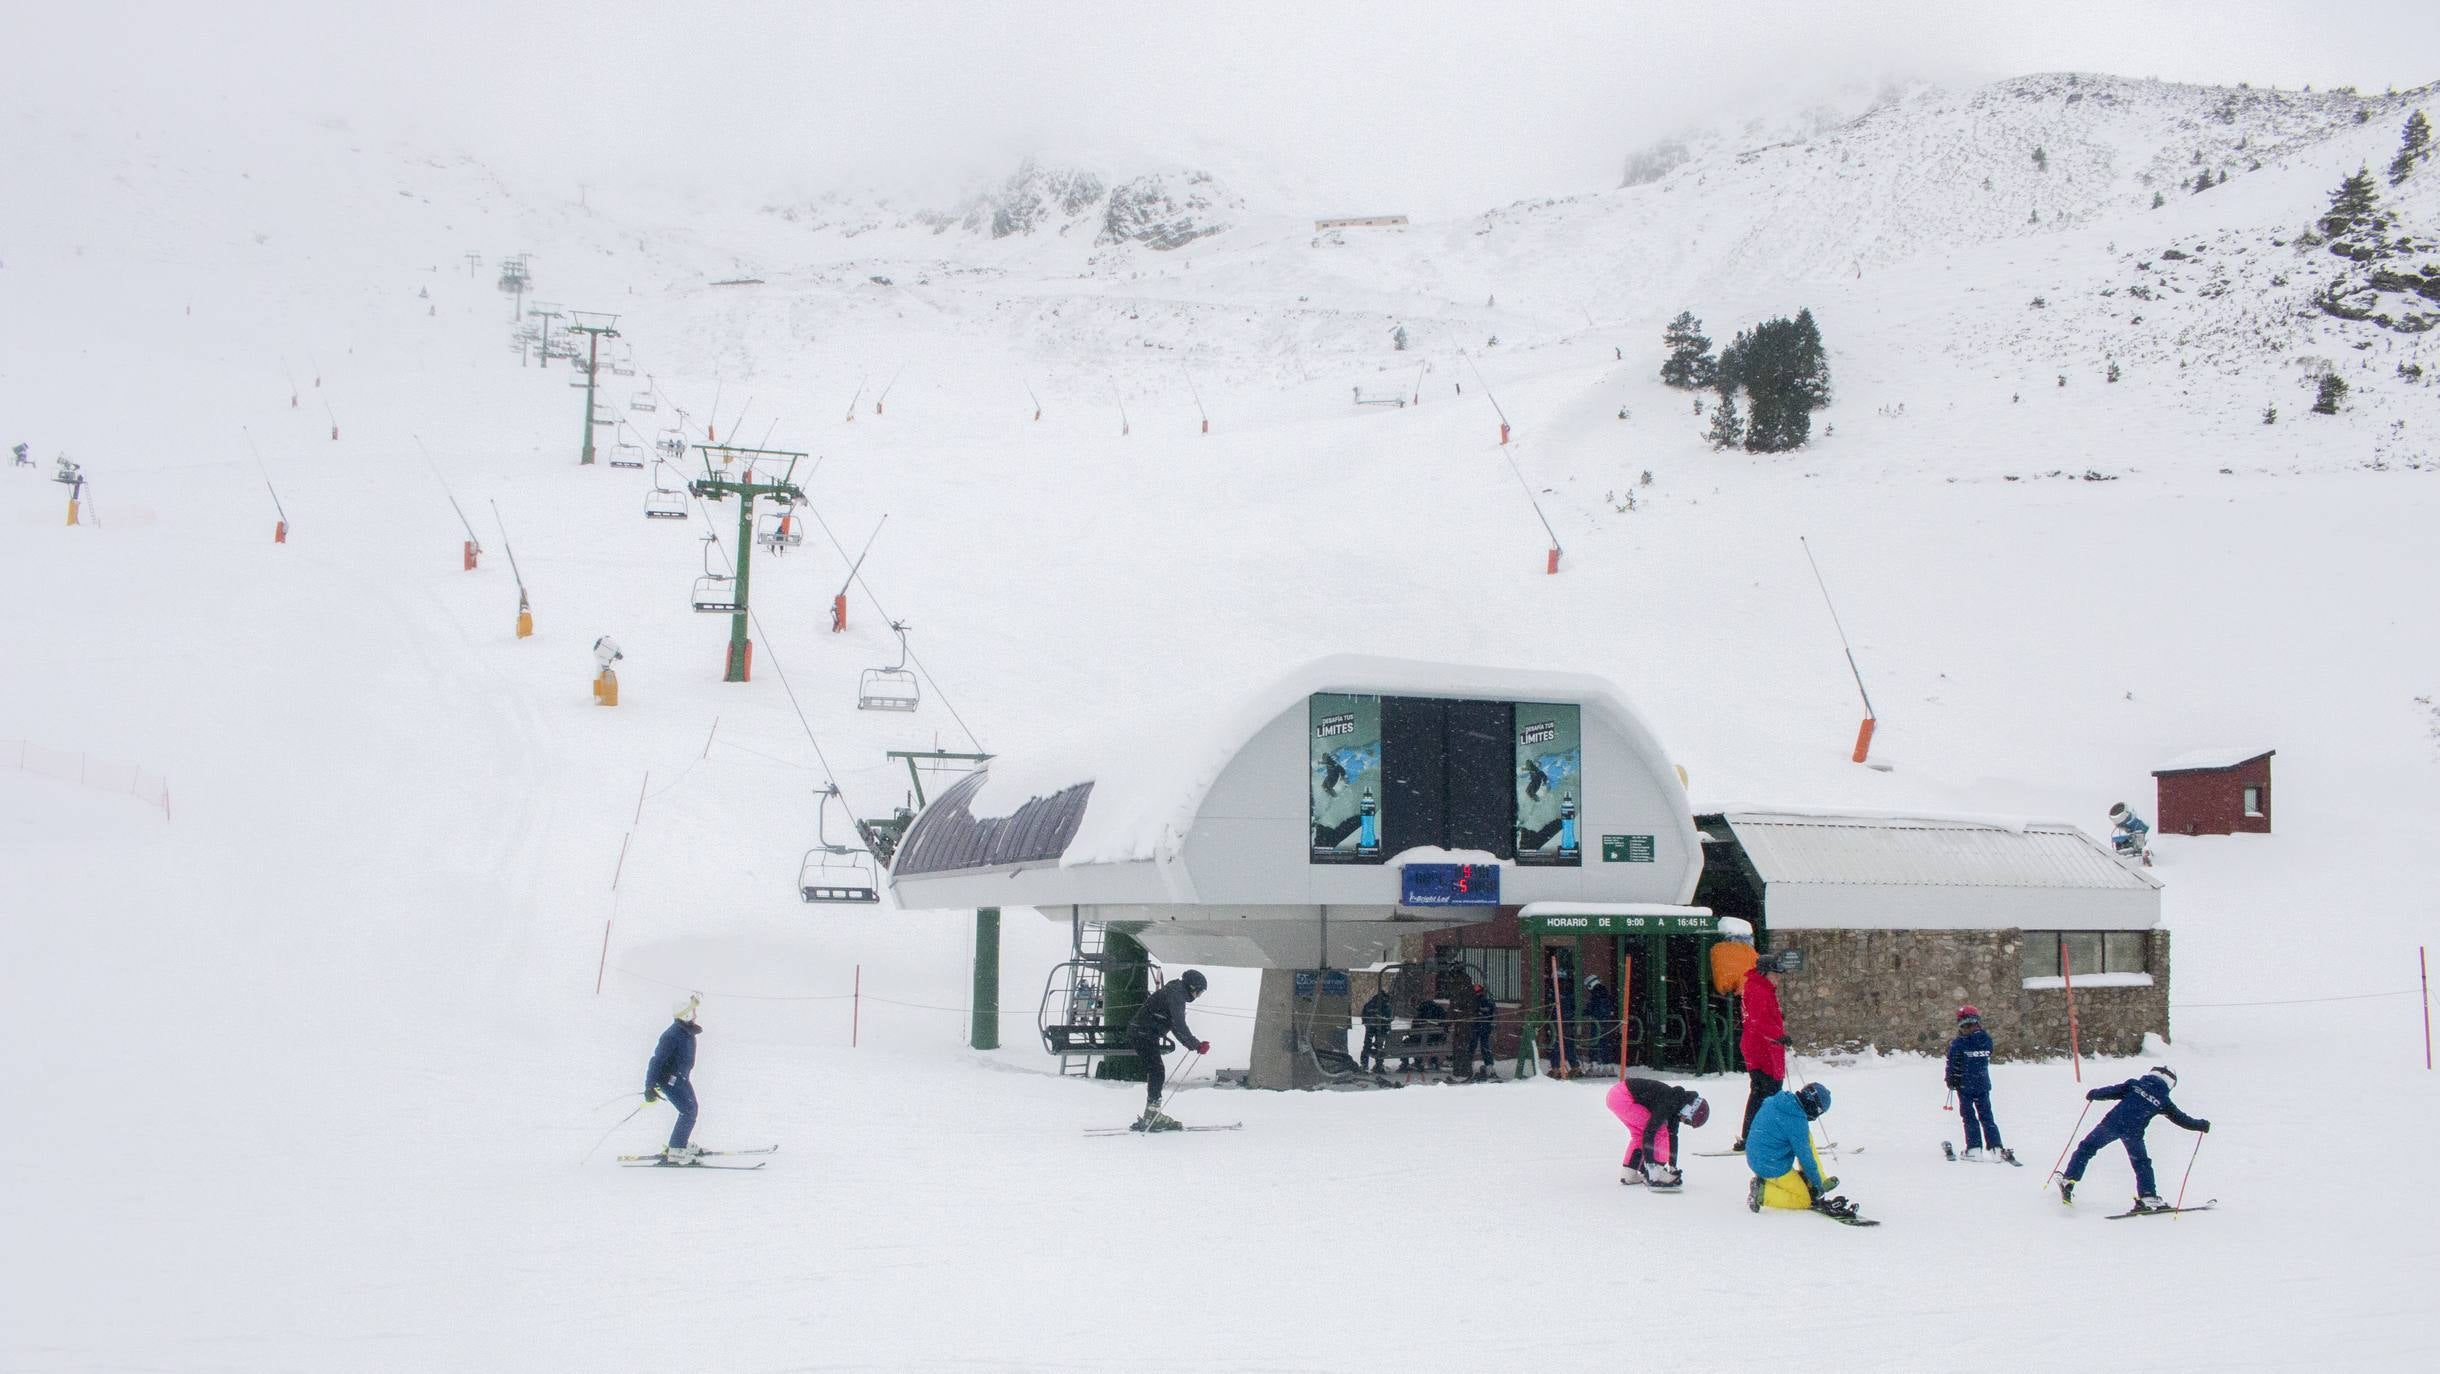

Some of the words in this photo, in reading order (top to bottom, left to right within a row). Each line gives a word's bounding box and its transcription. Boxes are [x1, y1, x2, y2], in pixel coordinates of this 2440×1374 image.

[1317, 722, 1354, 738] LÍMITES
[1520, 730, 1554, 745] LÍMITES
[1547, 918, 1588, 927] HORARIO
[1598, 918, 1611, 927] DE
[1626, 918, 1645, 927] 9:00
[1658, 918, 1665, 927] A
[1677, 918, 1698, 927] 16:45
